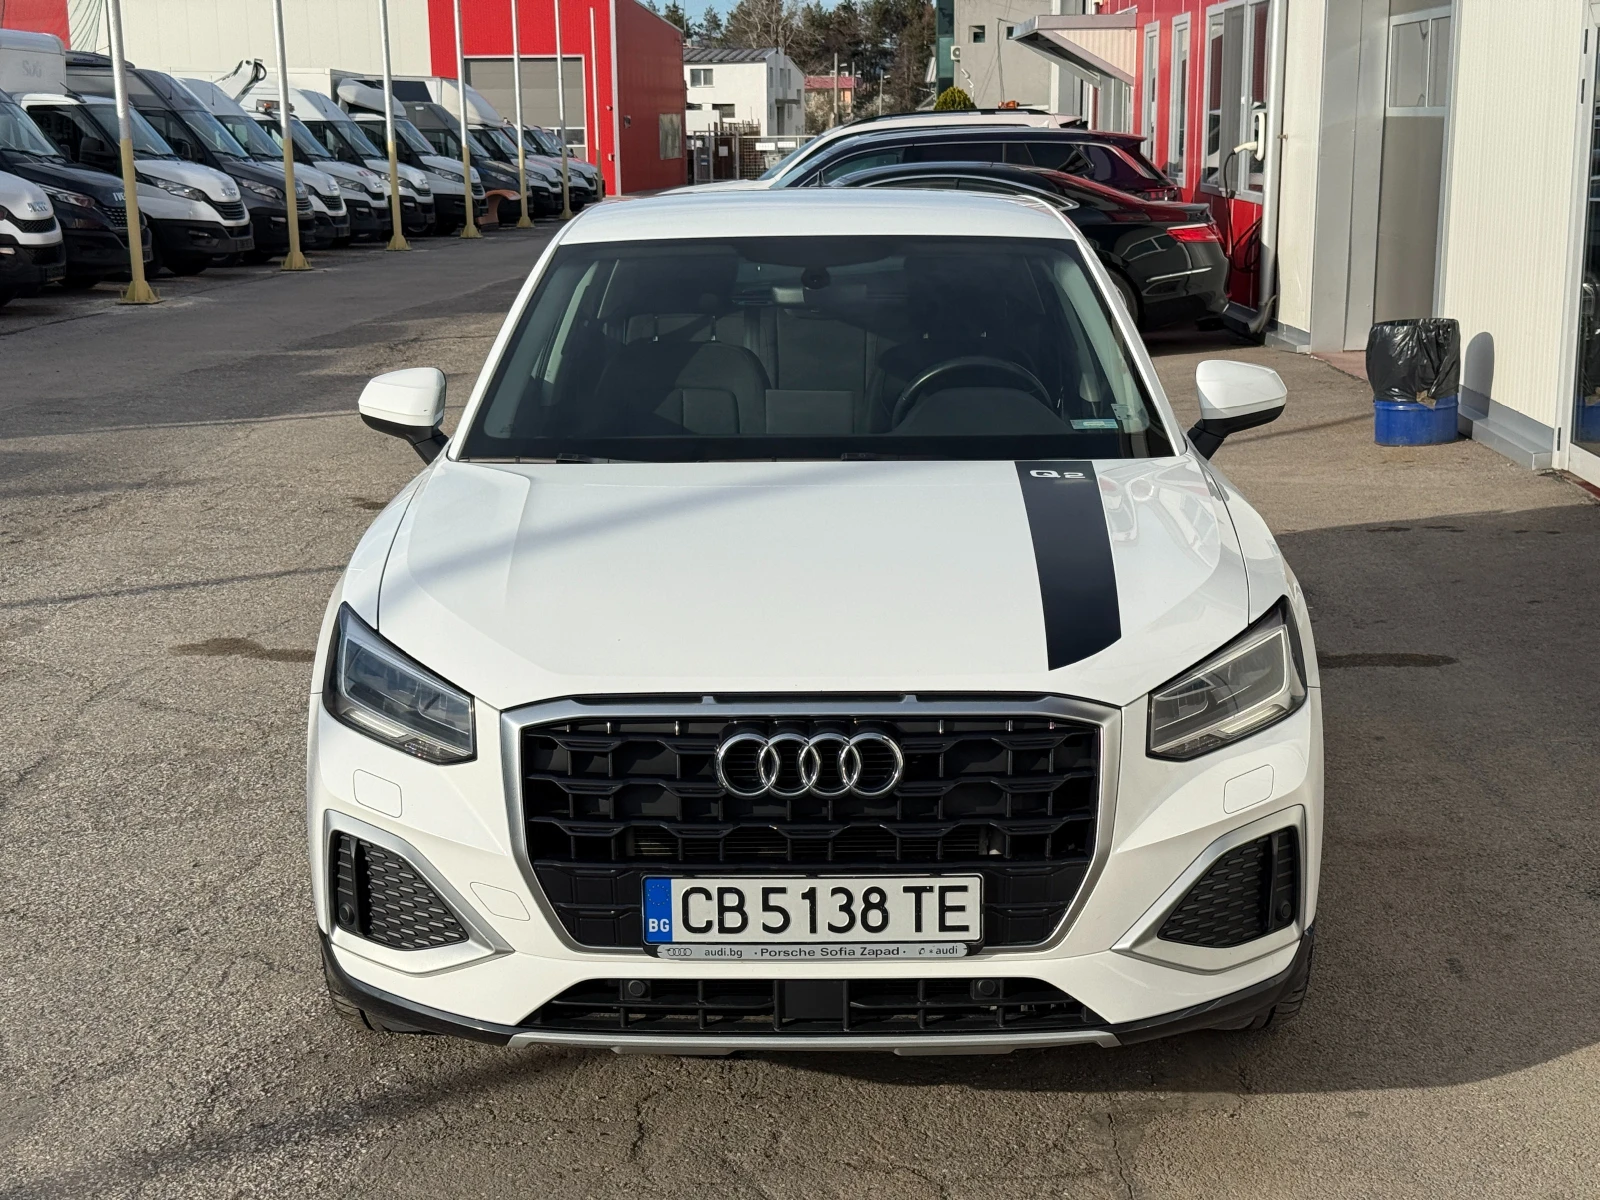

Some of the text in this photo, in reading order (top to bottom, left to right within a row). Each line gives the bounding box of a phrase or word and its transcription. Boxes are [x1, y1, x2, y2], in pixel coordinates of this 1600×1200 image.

[1029, 469, 1086, 479] Q2
[681, 884, 971, 935] CB 5138 TE
[648, 918, 670, 933] BG
[704, 947, 743, 959] audi.bg
[760, 946, 901, 959] Porsche Sofia Zapad
[935, 945, 958, 955] audi
